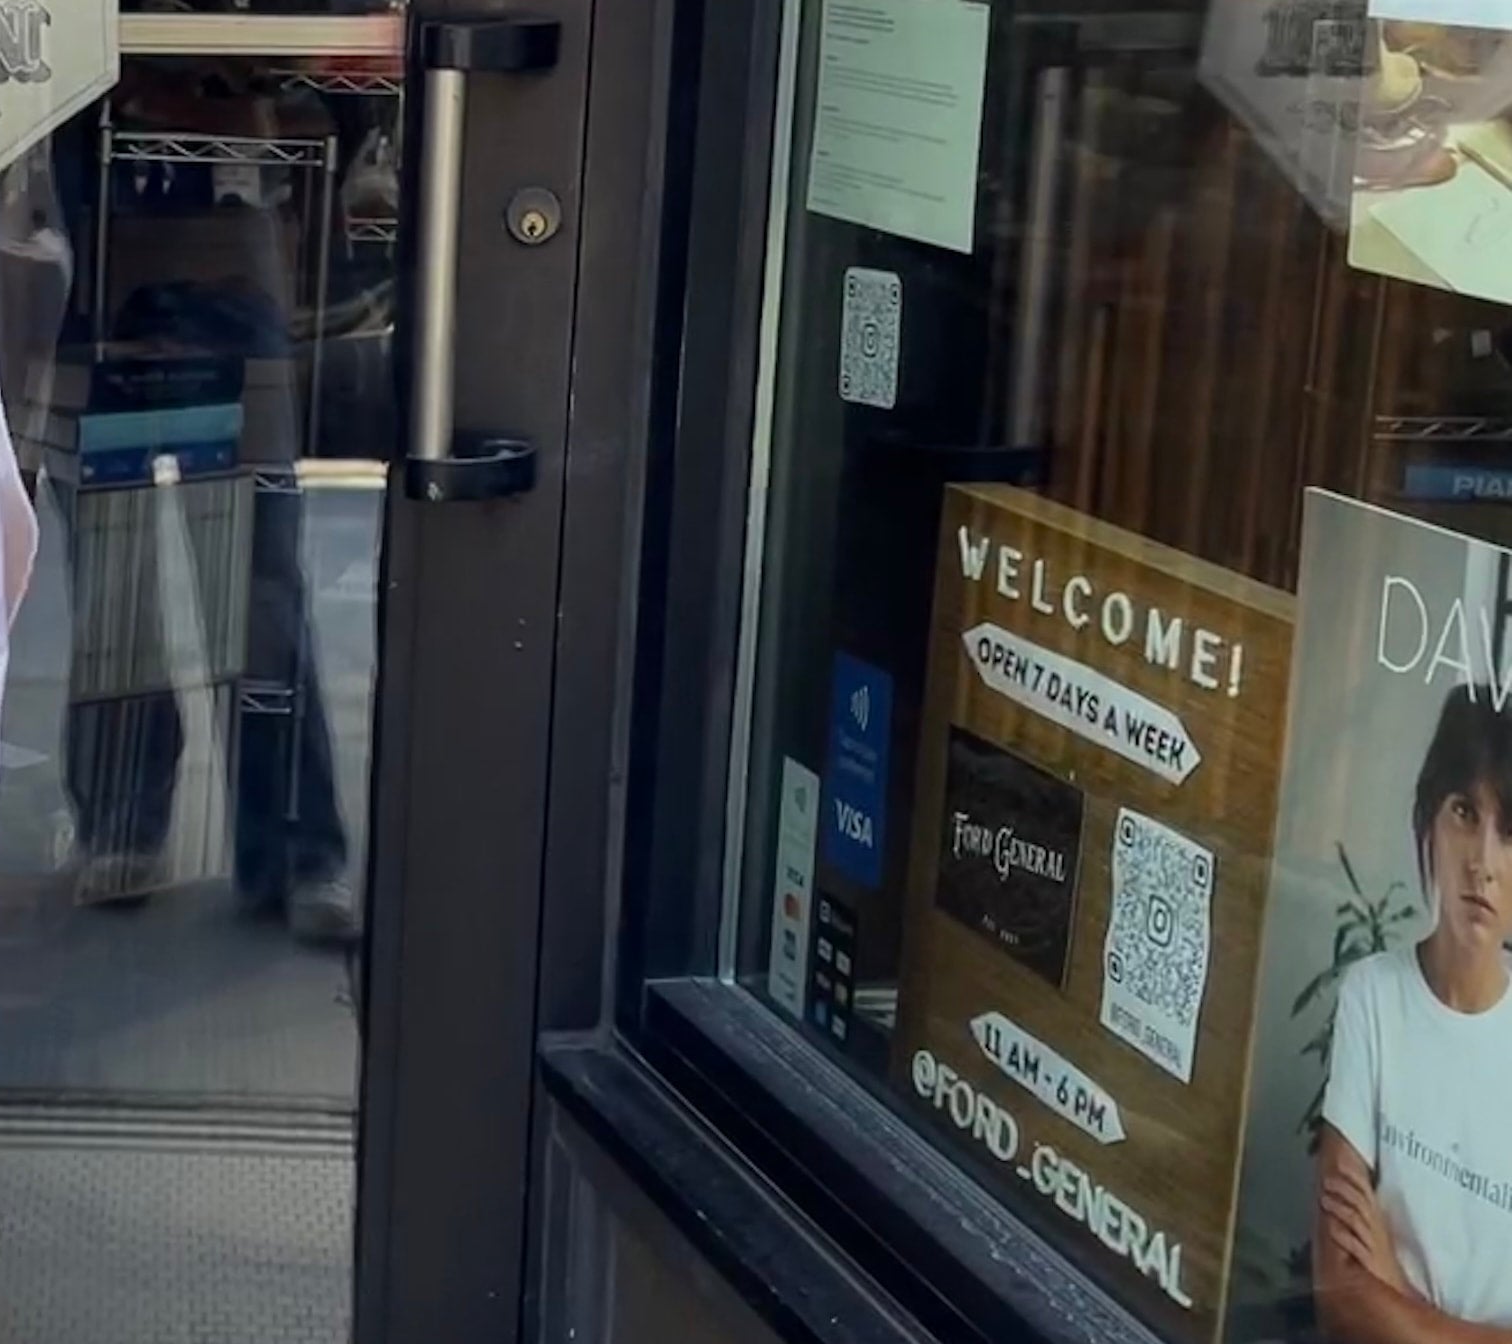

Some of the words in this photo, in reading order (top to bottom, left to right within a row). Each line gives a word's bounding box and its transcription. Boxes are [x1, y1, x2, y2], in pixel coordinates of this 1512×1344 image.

[1452, 473, 1512, 498] PIA
[958, 524, 1243, 698] WELCOME!
[977, 637, 1029, 687] OPEN
[1030, 664, 1048, 691] 7
[1046, 672, 1100, 724] DAYS
[1103, 705, 1119, 737] A
[1124, 714, 1186, 772] WEEK
[834, 797, 874, 850] VISA
[983, 1022, 1002, 1057] 11
[1007, 1041, 1040, 1086] AM
[1055, 1074, 1069, 1106] 6
[1074, 1088, 1108, 1134] PM
[912, 1049, 1193, 1309] @FORD_GENERAL
